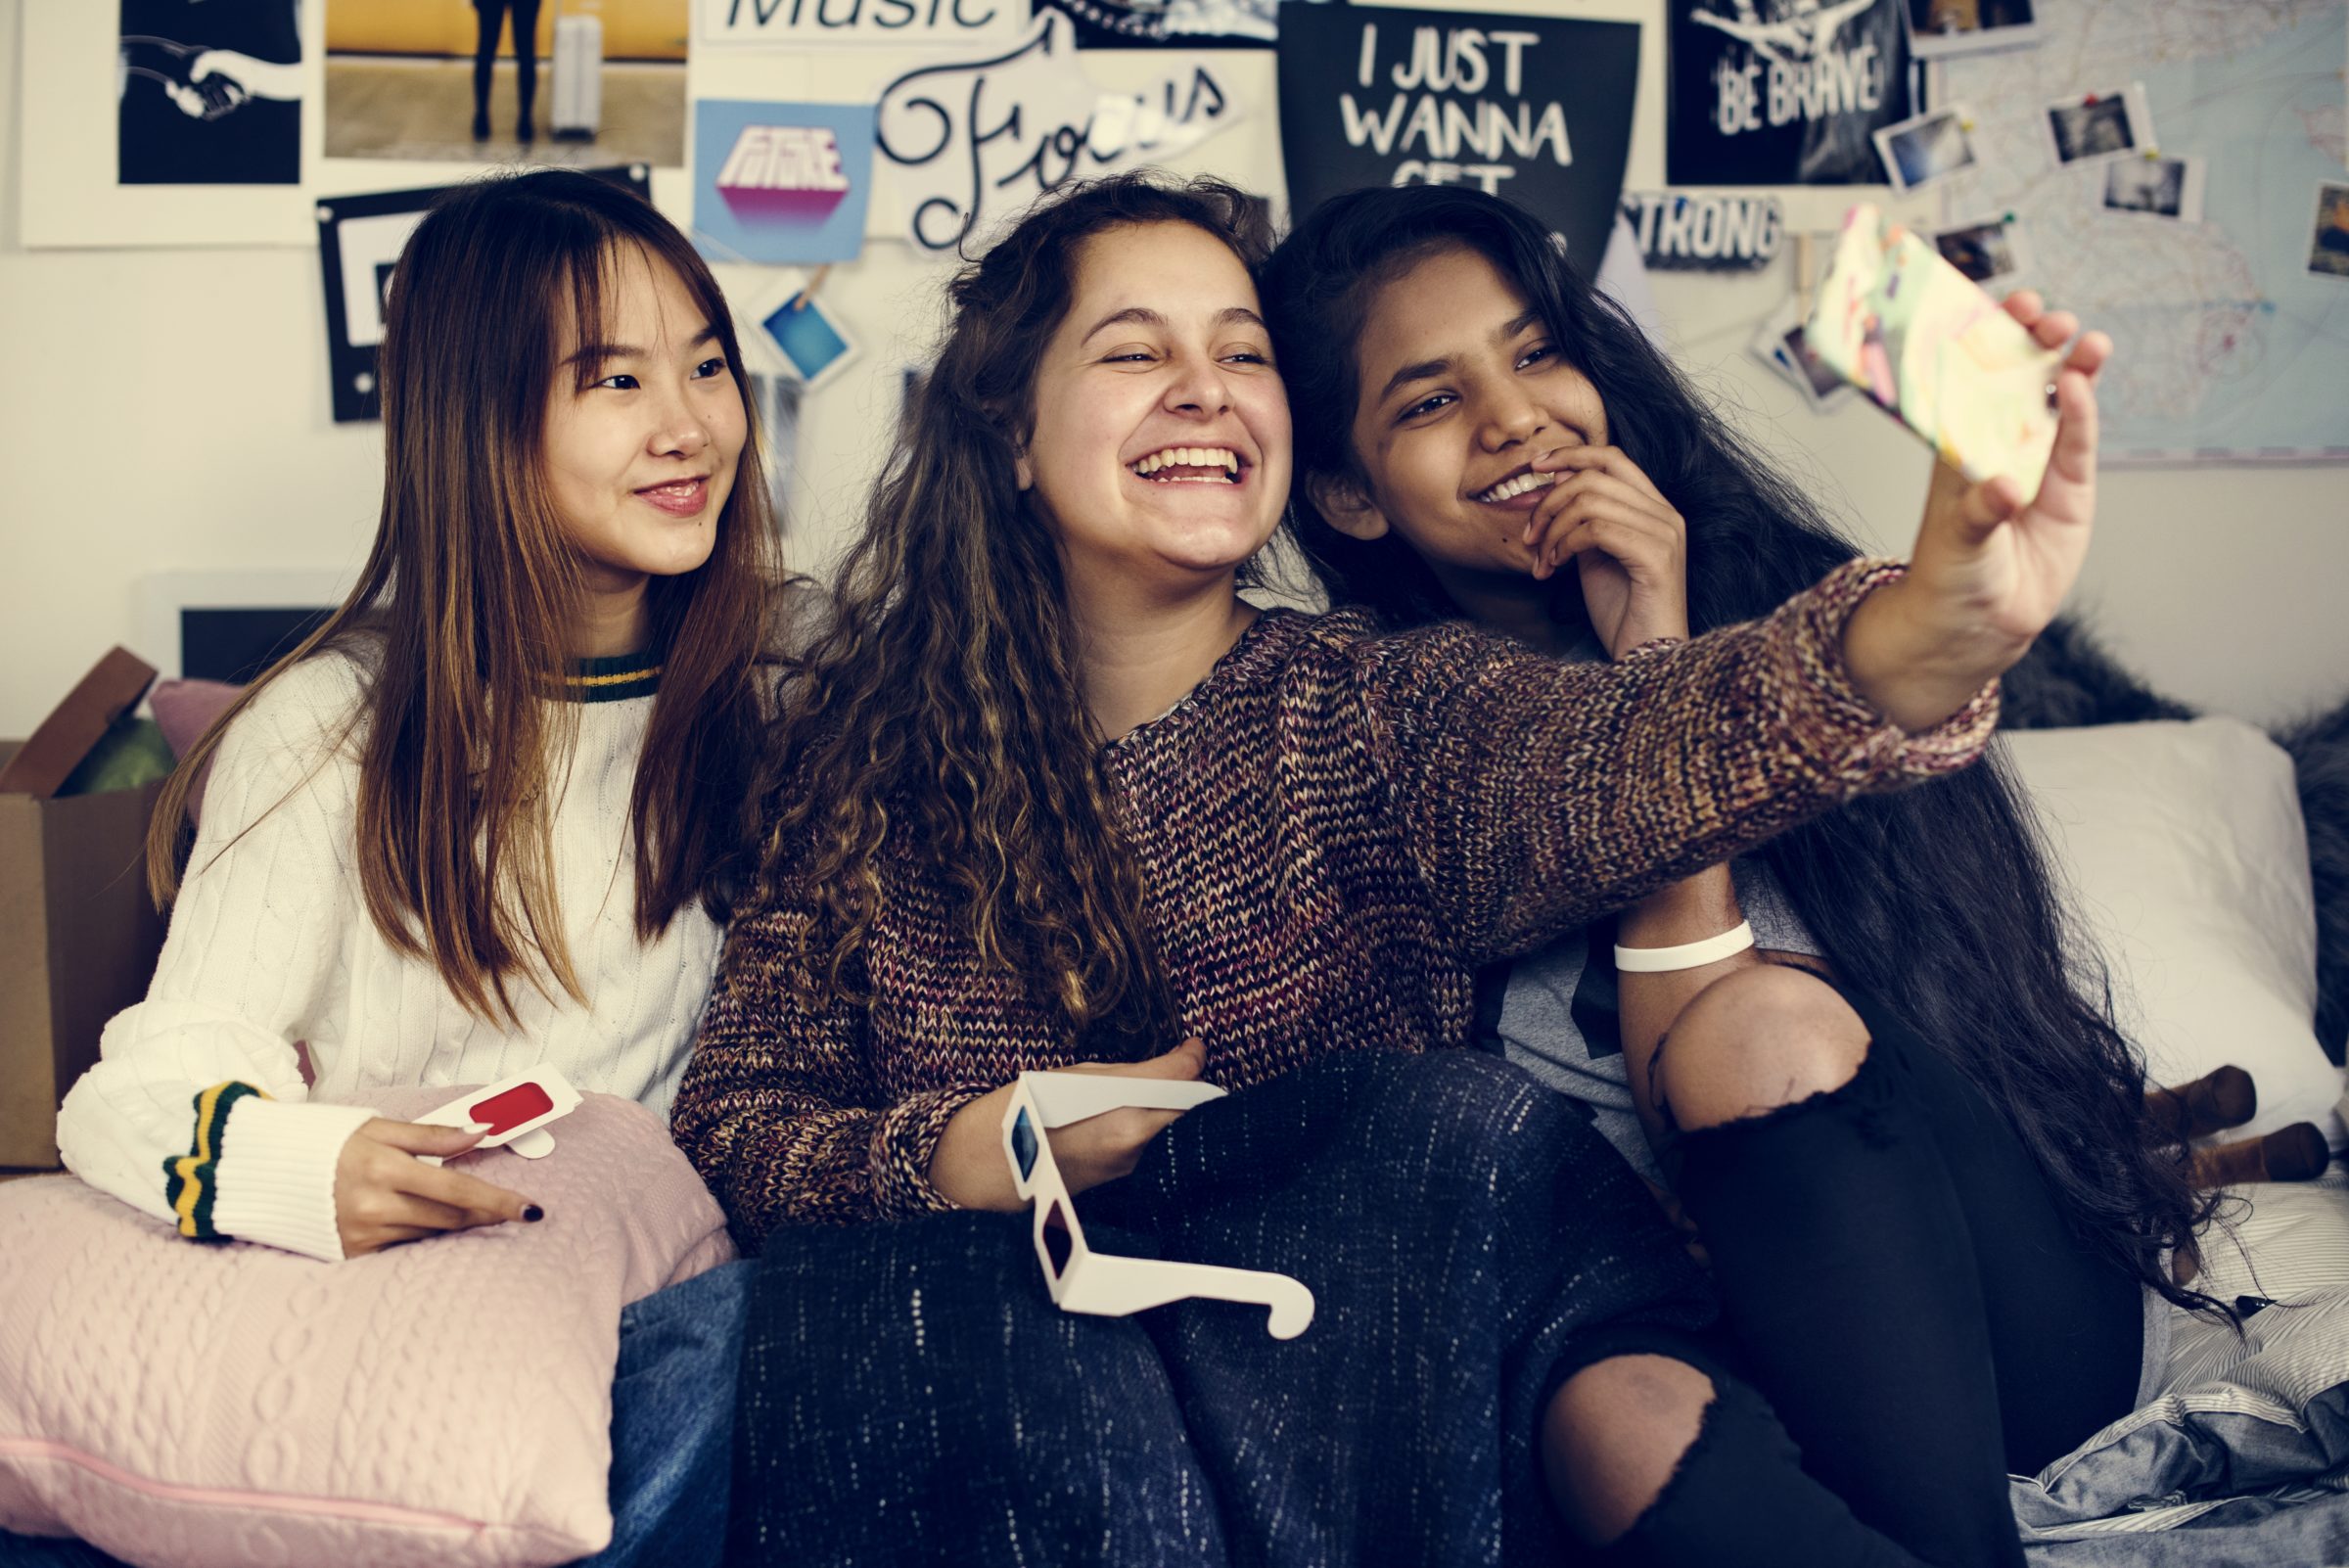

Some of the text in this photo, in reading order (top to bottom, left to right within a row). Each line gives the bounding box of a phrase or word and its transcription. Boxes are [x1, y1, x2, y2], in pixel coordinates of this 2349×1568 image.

[1358, 22, 1541, 96] I JUST
[1718, 43, 1881, 135] BE BRAVE
[1339, 92, 1573, 166] WANNA
[1622, 195, 1782, 261] TRONG
